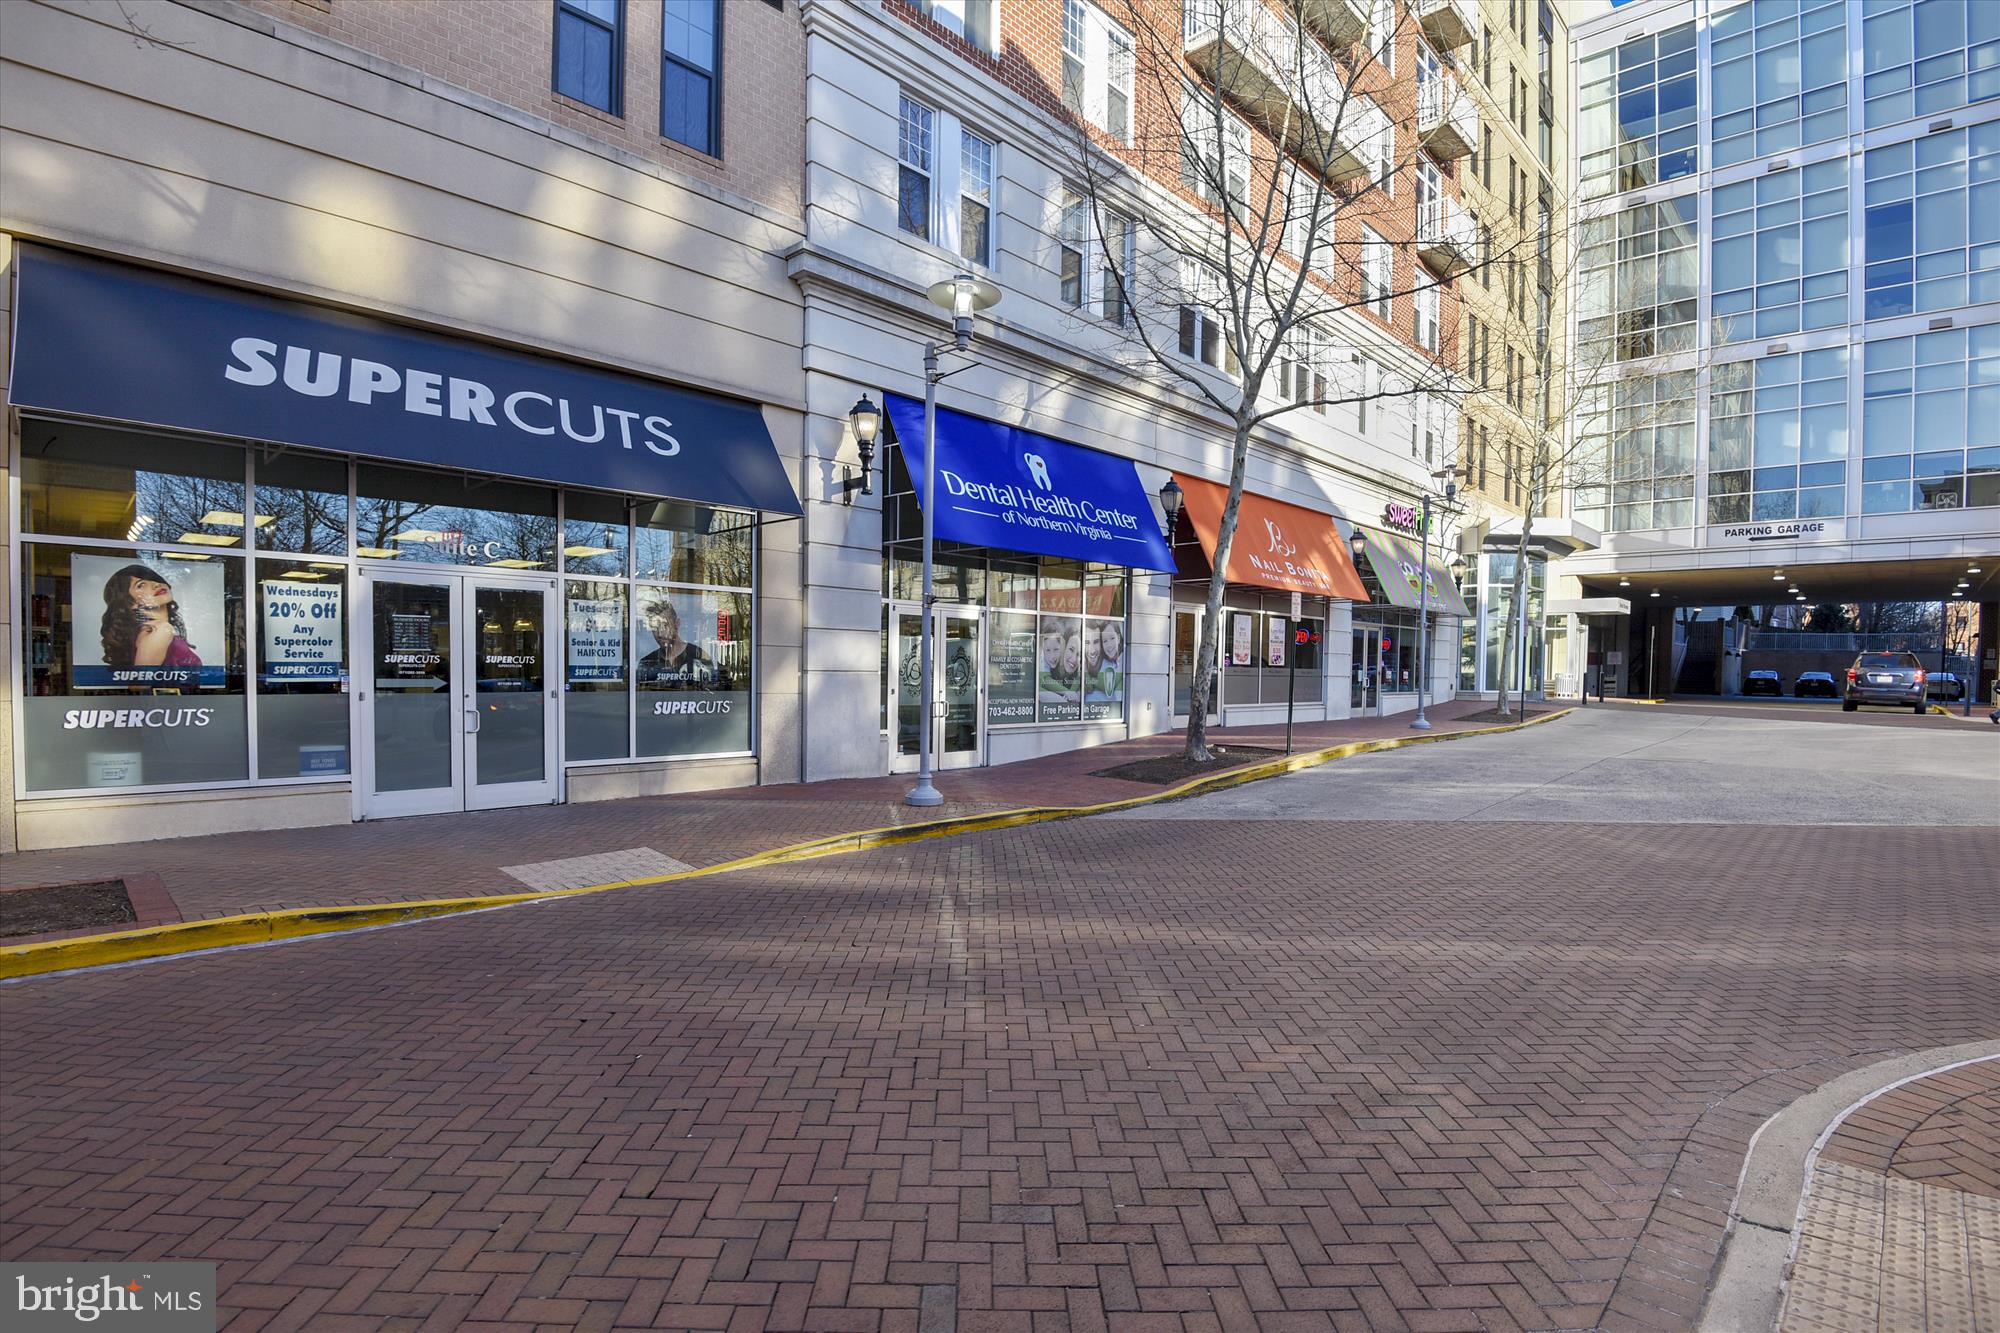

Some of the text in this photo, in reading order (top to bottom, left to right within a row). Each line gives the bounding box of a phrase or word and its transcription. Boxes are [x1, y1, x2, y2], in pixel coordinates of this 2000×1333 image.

[224, 337, 681, 457] SUPERCUTS
[940, 470, 1138, 530] Dental Health Center
[1002, 510, 1112, 540] of Northern Virginia
[1725, 523, 1825, 537] PARKING GARAGE
[484, 541, 500, 559] C
[1249, 554, 1329, 581] NAIL BONITA
[266, 585, 339, 600] Wednesdays
[269, 602, 337, 619] 20% Off
[293, 624, 315, 635] Any
[274, 636, 333, 648] Supercolor
[571, 638, 621, 647] Senior & Kid
[284, 648, 325, 659] Service
[384, 654, 440, 663] SUPERCUTS
[577, 649, 616, 657] HAIRCUTS
[485, 655, 536, 664] SUPERCUTS
[112, 670, 190, 681] SUPERCUTS
[273, 665, 334, 675] SUPERCUTS
[574, 668, 618, 676] SUPERCUTS
[657, 672, 697, 681] SUPERCUTS
[654, 700, 730, 715] SUPERCUTS
[988, 706, 1034, 717] 703-462-8800
[1043, 705, 1057, 715] Free
[1057, 704, 1080, 716] Parking
[1090, 704, 1110, 715] Garage
[63, 708, 211, 729] SUPERCUTS
